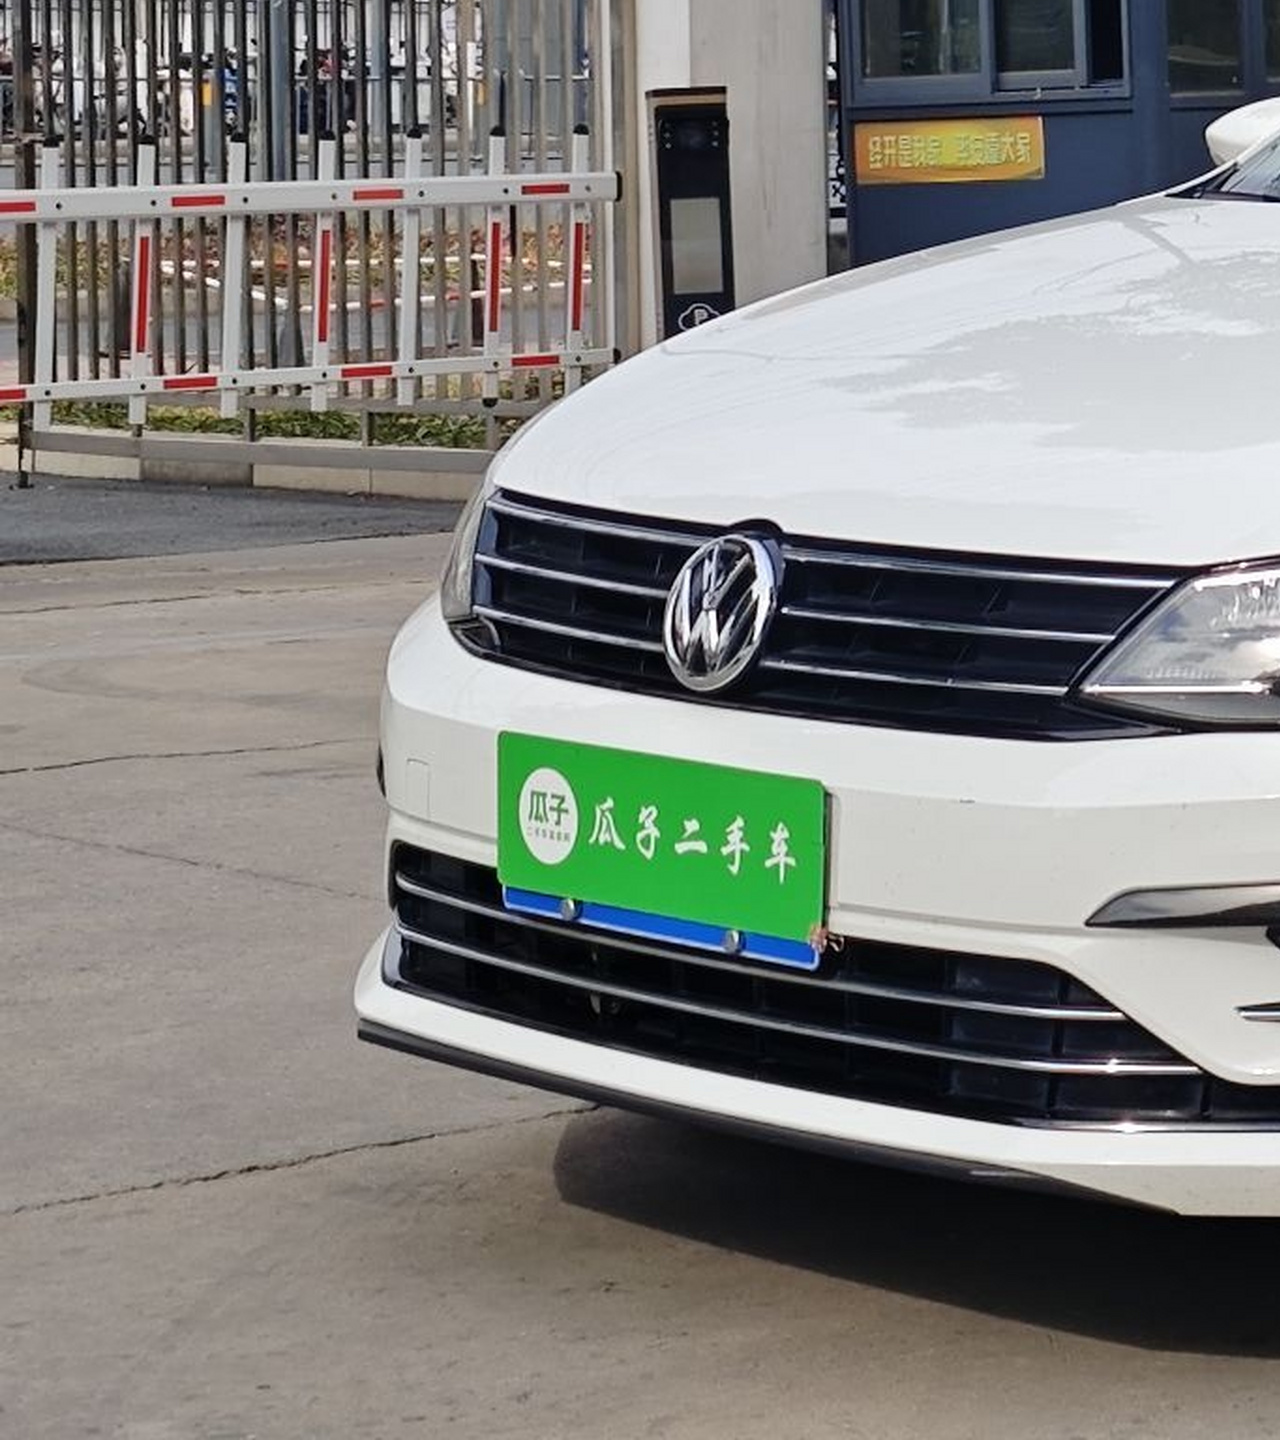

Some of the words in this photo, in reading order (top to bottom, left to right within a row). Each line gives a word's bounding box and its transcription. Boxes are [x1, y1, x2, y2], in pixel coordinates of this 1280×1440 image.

[529, 790, 569, 826] 瓜子
[589, 797, 797, 884] 瓜子二手车
